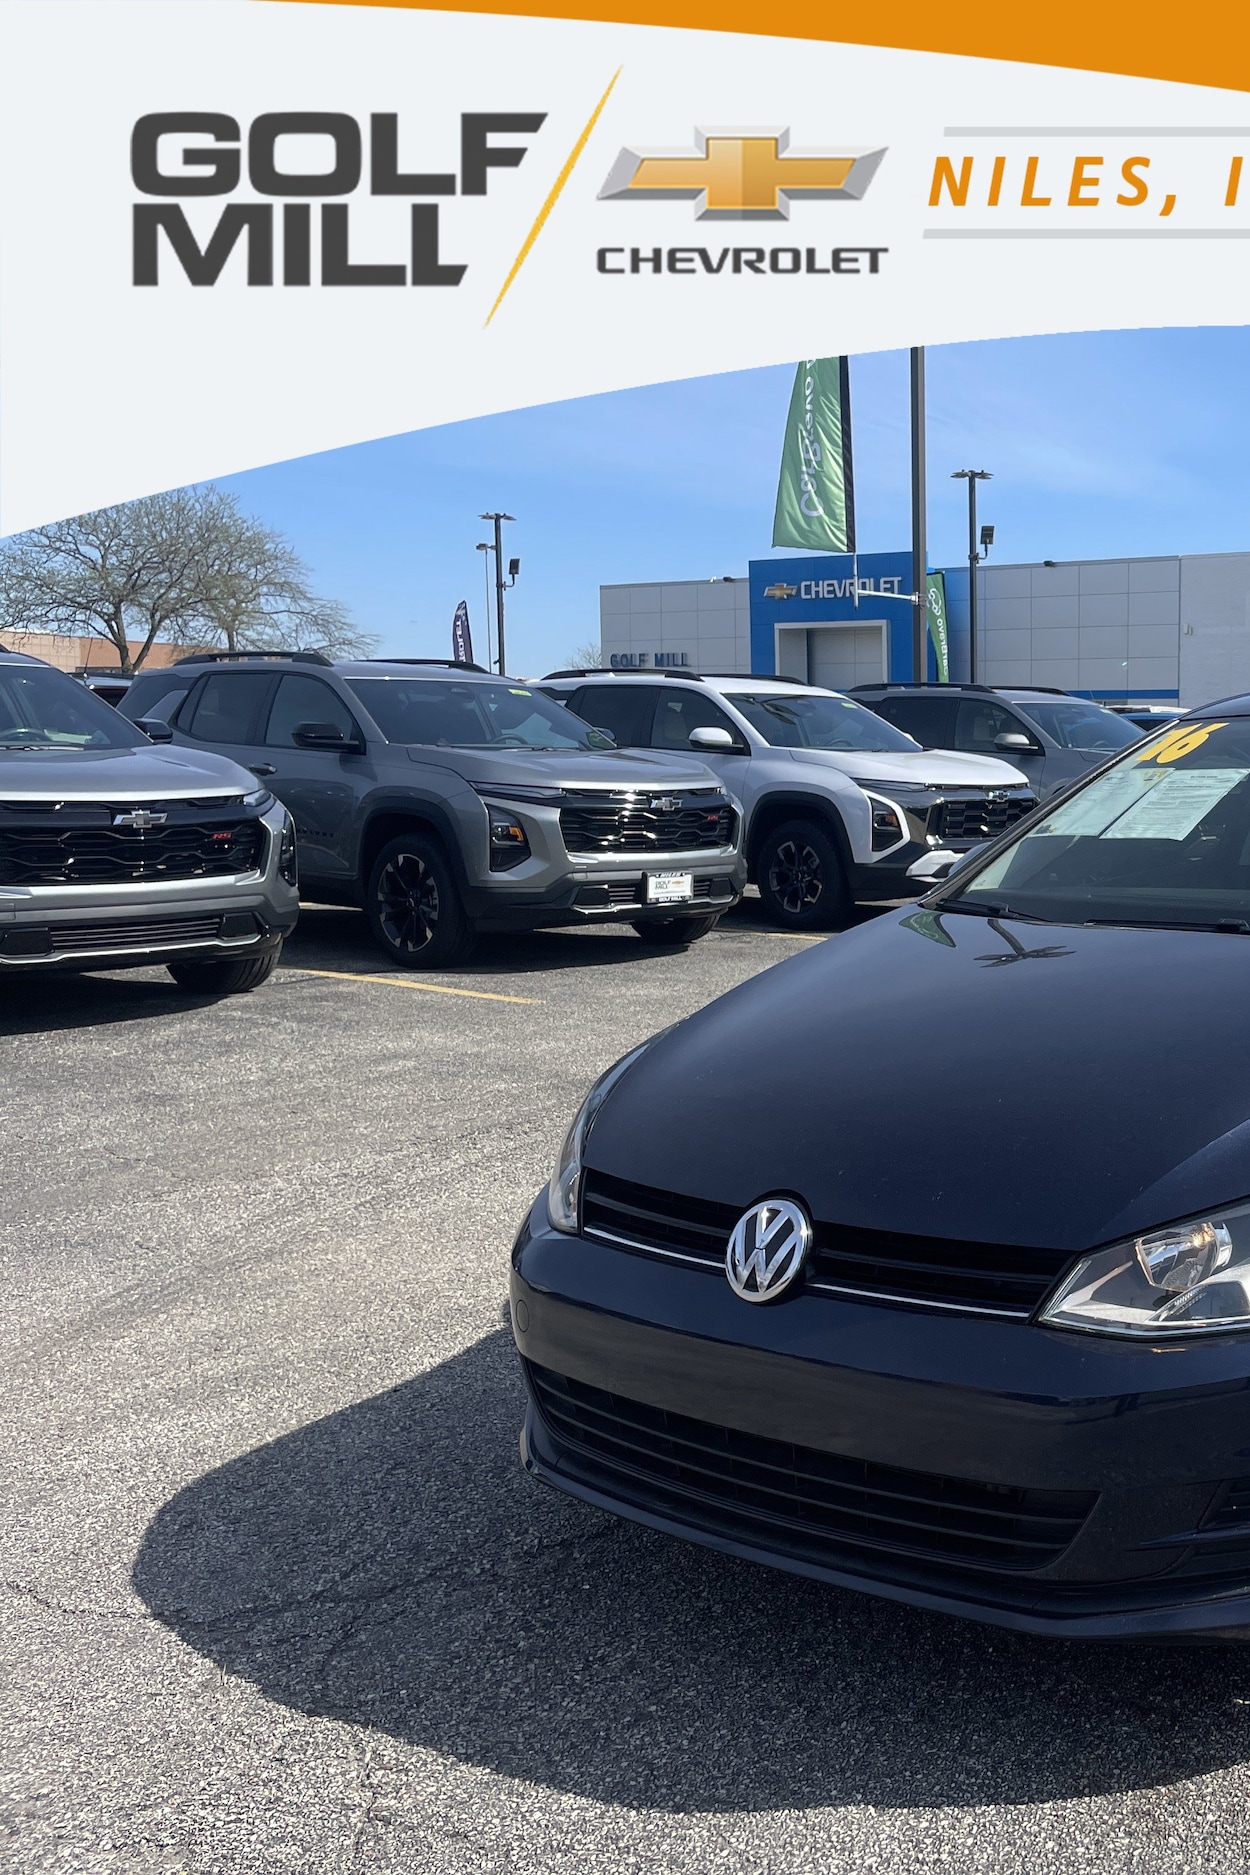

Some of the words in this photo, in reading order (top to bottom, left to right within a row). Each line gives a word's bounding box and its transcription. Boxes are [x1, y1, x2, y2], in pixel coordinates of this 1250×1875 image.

[800, 576, 902, 600] CHEVROLET
[610, 653, 646, 668] GOLF
[654, 652, 689, 667] MILL
[1135, 722, 1230, 764] 16
